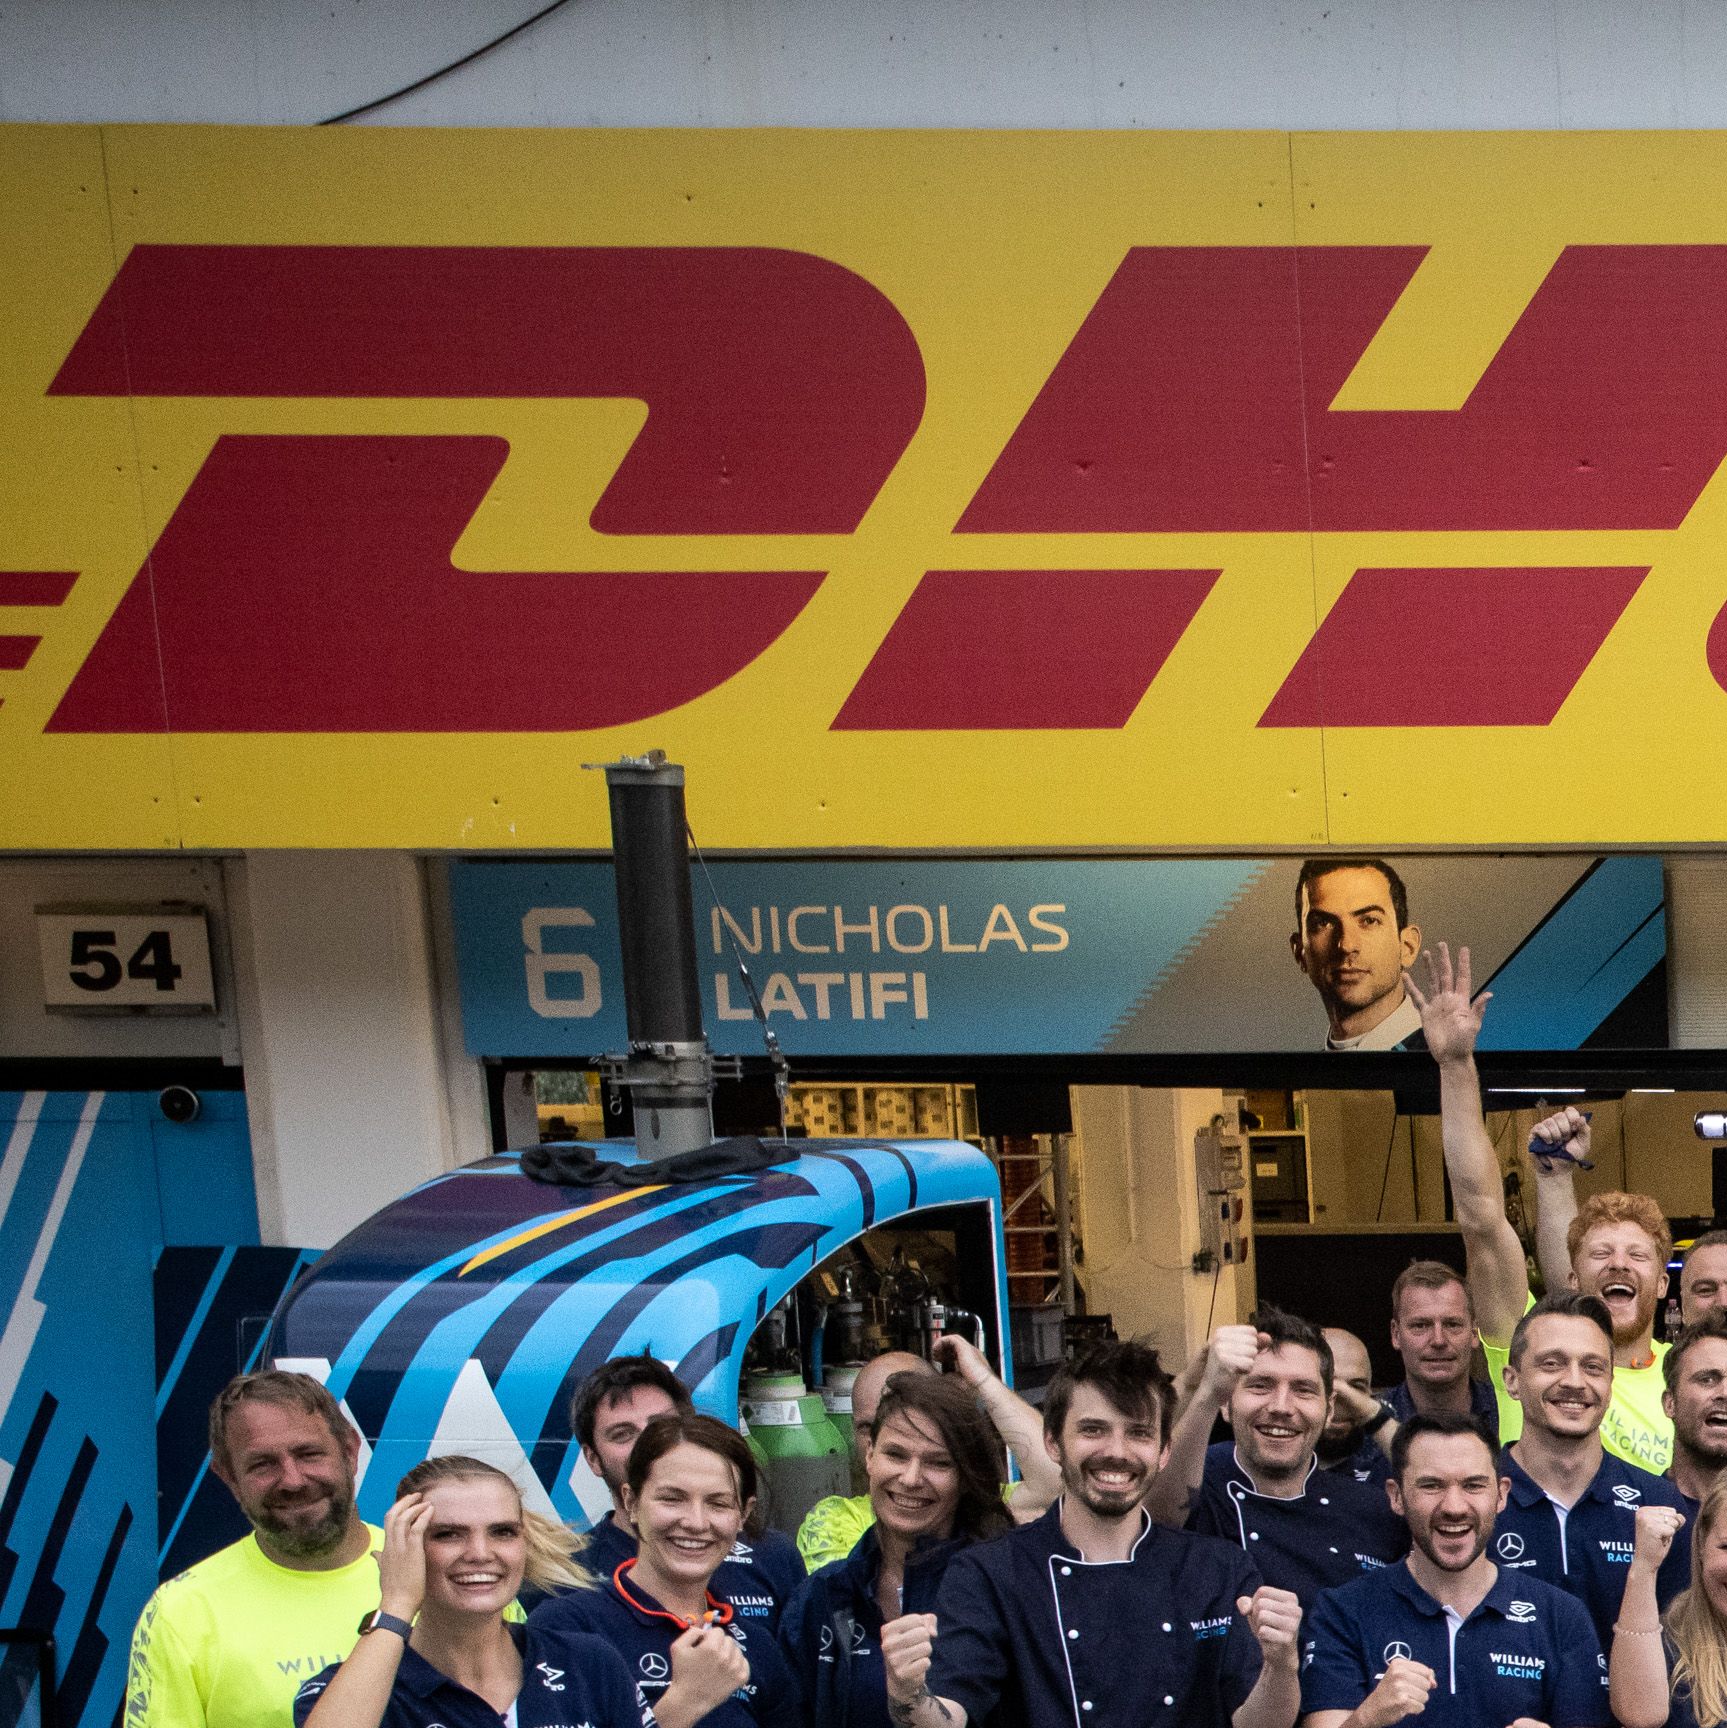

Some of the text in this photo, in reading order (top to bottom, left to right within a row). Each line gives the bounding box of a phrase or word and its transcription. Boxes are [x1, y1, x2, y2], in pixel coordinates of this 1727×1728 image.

[710, 903, 1070, 955] NICHOLAS
[69, 931, 182, 992] 54
[521, 907, 602, 1018] 6
[715, 972, 929, 1021] LATIFI
[1614, 1499, 1640, 1512] umbro
[1599, 1540, 1635, 1553] WILLI
[1607, 1553, 1634, 1563] RACI
[727, 1595, 774, 1606] ILLIAMS
[740, 1607, 769, 1617] CING
[1506, 1613, 1537, 1623] umbro
[1497, 1665, 1542, 1680] RACING
